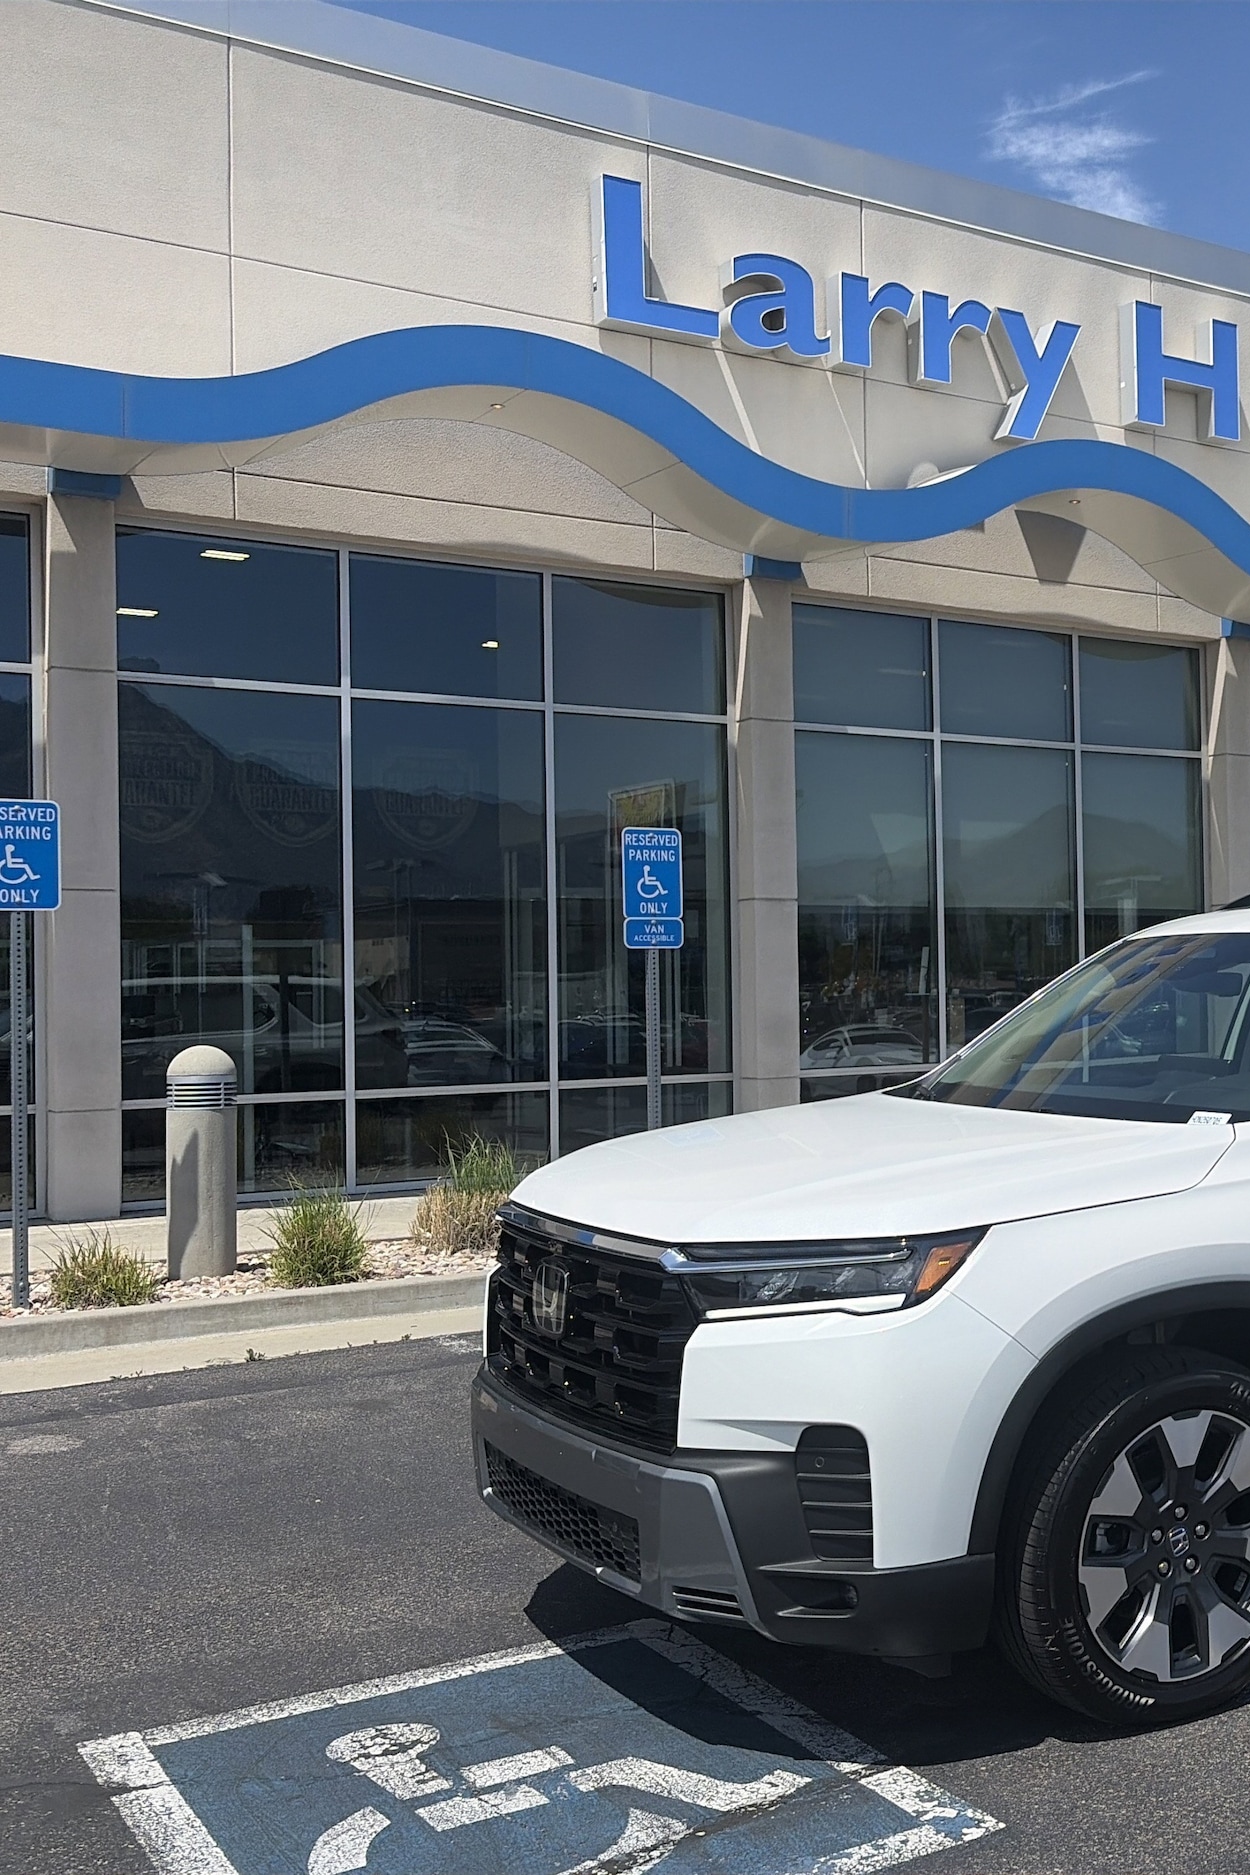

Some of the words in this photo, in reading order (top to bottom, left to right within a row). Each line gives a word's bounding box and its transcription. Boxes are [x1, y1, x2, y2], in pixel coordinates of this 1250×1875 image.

[600, 172, 1083, 441] Larry
[1134, 299, 1241, 441] H
[0, 807, 56, 822] SERVED
[0, 826, 52, 840] RKING
[625, 834, 678, 846] RESERVED
[629, 849, 676, 862] PARKING
[0, 888, 39, 903] ONLY
[640, 902, 668, 914] ONLY
[644, 925, 664, 934] VAN
[634, 934, 675, 942] ACCESSIBLE
